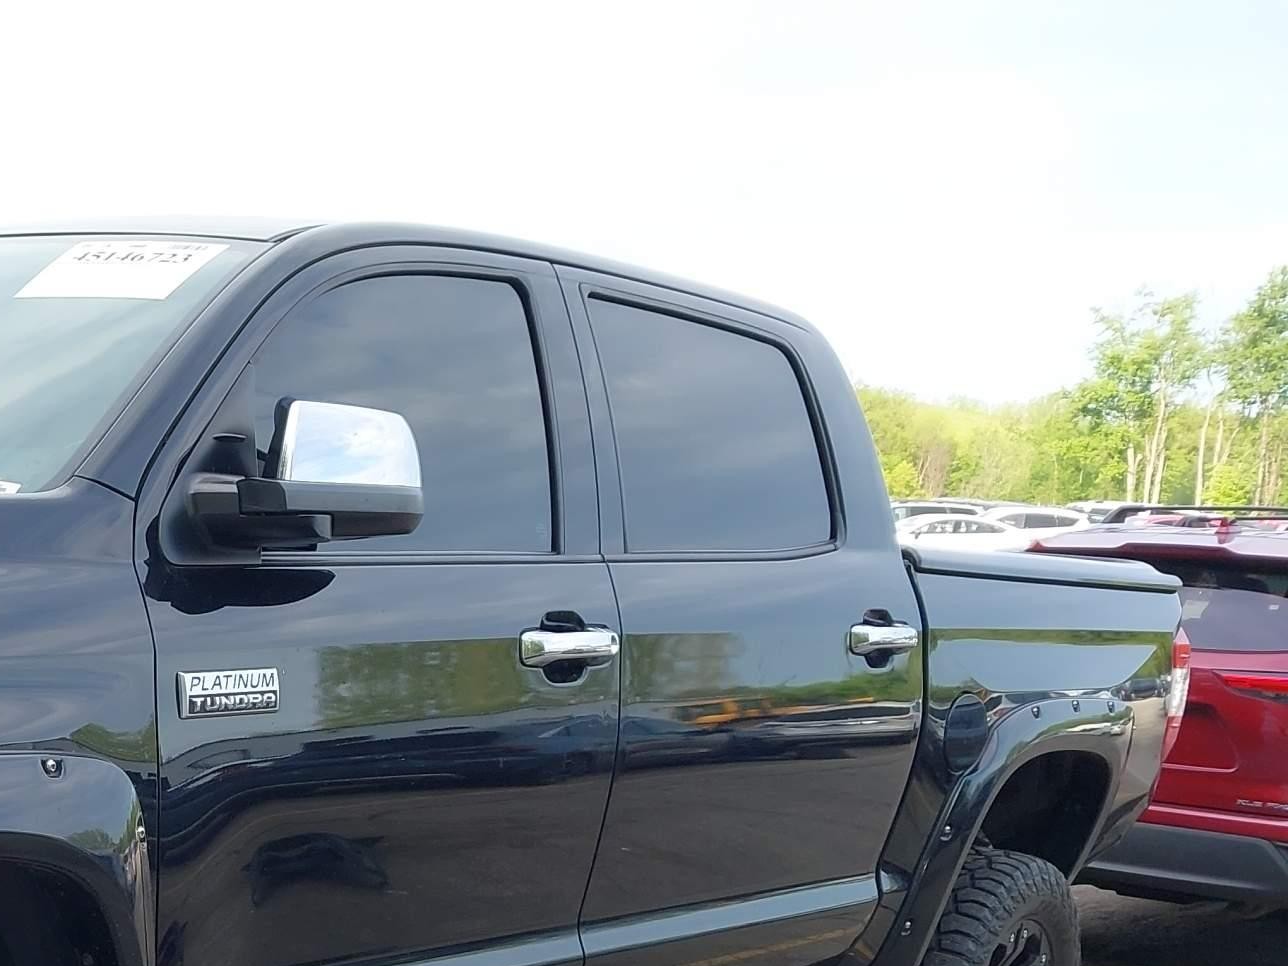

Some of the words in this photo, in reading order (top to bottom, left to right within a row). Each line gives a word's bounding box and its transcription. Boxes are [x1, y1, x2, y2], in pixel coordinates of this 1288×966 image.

[72, 251, 193, 264] 45146723
[190, 673, 275, 692] PLATINUM
[190, 692, 276, 713] TUNDRA
